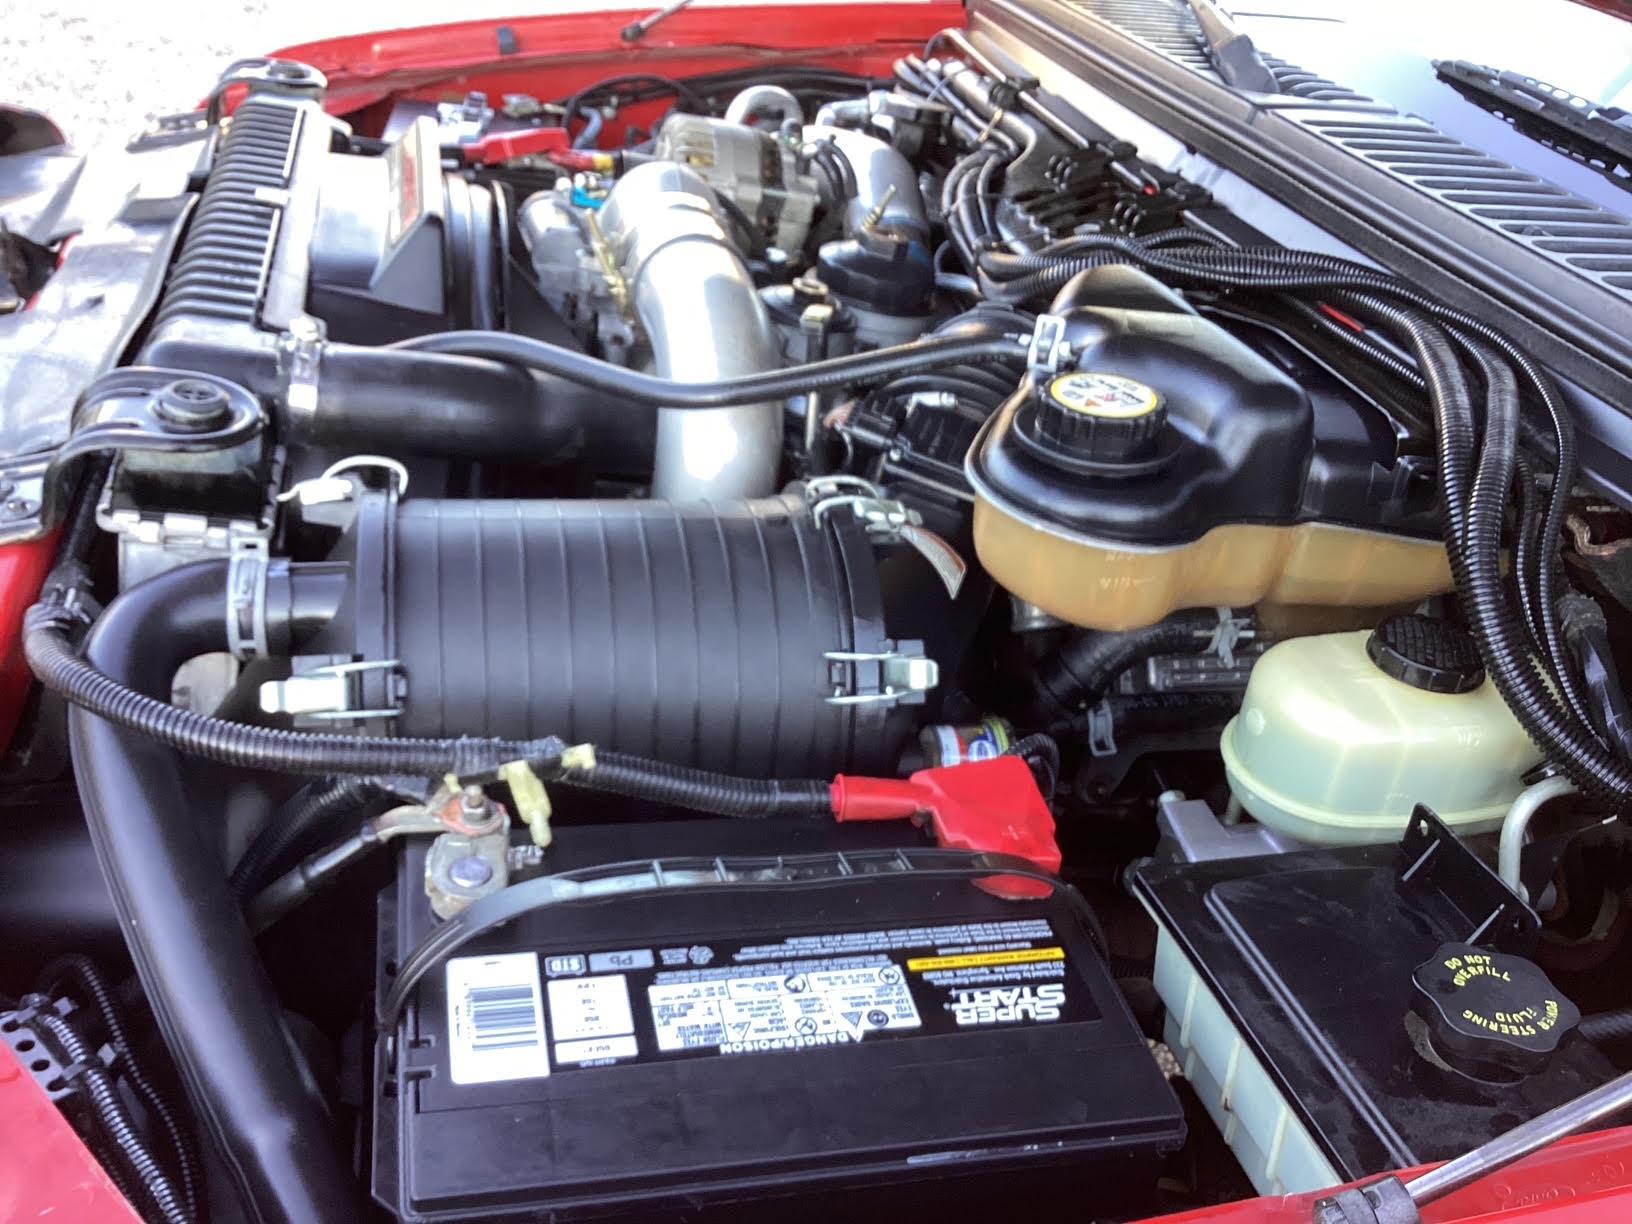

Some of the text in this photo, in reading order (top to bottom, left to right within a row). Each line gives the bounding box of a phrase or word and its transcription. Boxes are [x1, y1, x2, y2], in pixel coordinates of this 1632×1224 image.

[609, 954, 633, 966] Pb
[1444, 954, 1491, 970] DO NOT
[1453, 966, 1511, 987] OVERFILL
[950, 982, 1066, 1011] START
[955, 1001, 1061, 1026] SUPER
[1462, 999, 1560, 1036] POWER STEERING
[720, 1031, 849, 1054] DANGER/POISON
